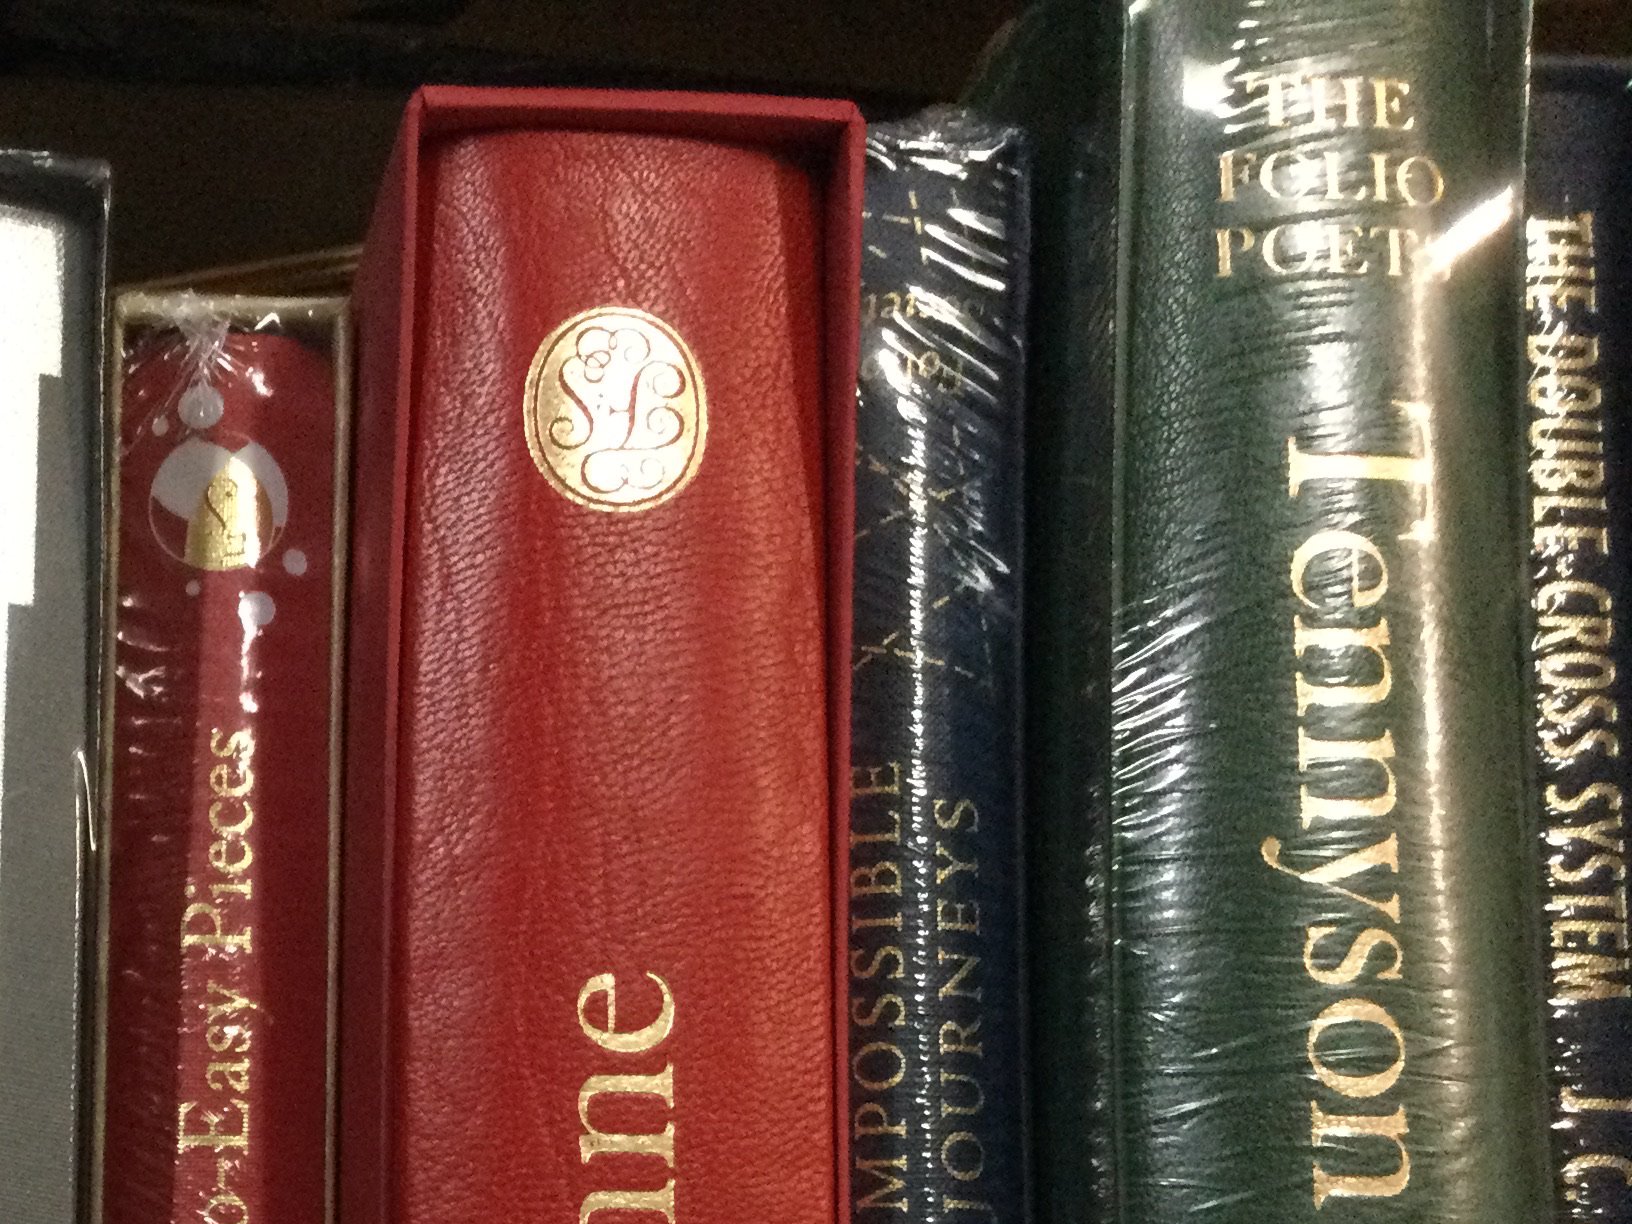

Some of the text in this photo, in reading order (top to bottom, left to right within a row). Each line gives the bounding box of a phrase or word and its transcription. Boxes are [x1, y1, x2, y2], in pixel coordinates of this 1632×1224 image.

[1215, 225, 1452, 278] POET
[1216, 151, 1444, 207] FOLIO
[180, 727, 255, 955] Pieces
[1261, 398, 1434, 1210] Tennyson
[1546, 782, 1630, 1000] SYSTEM
